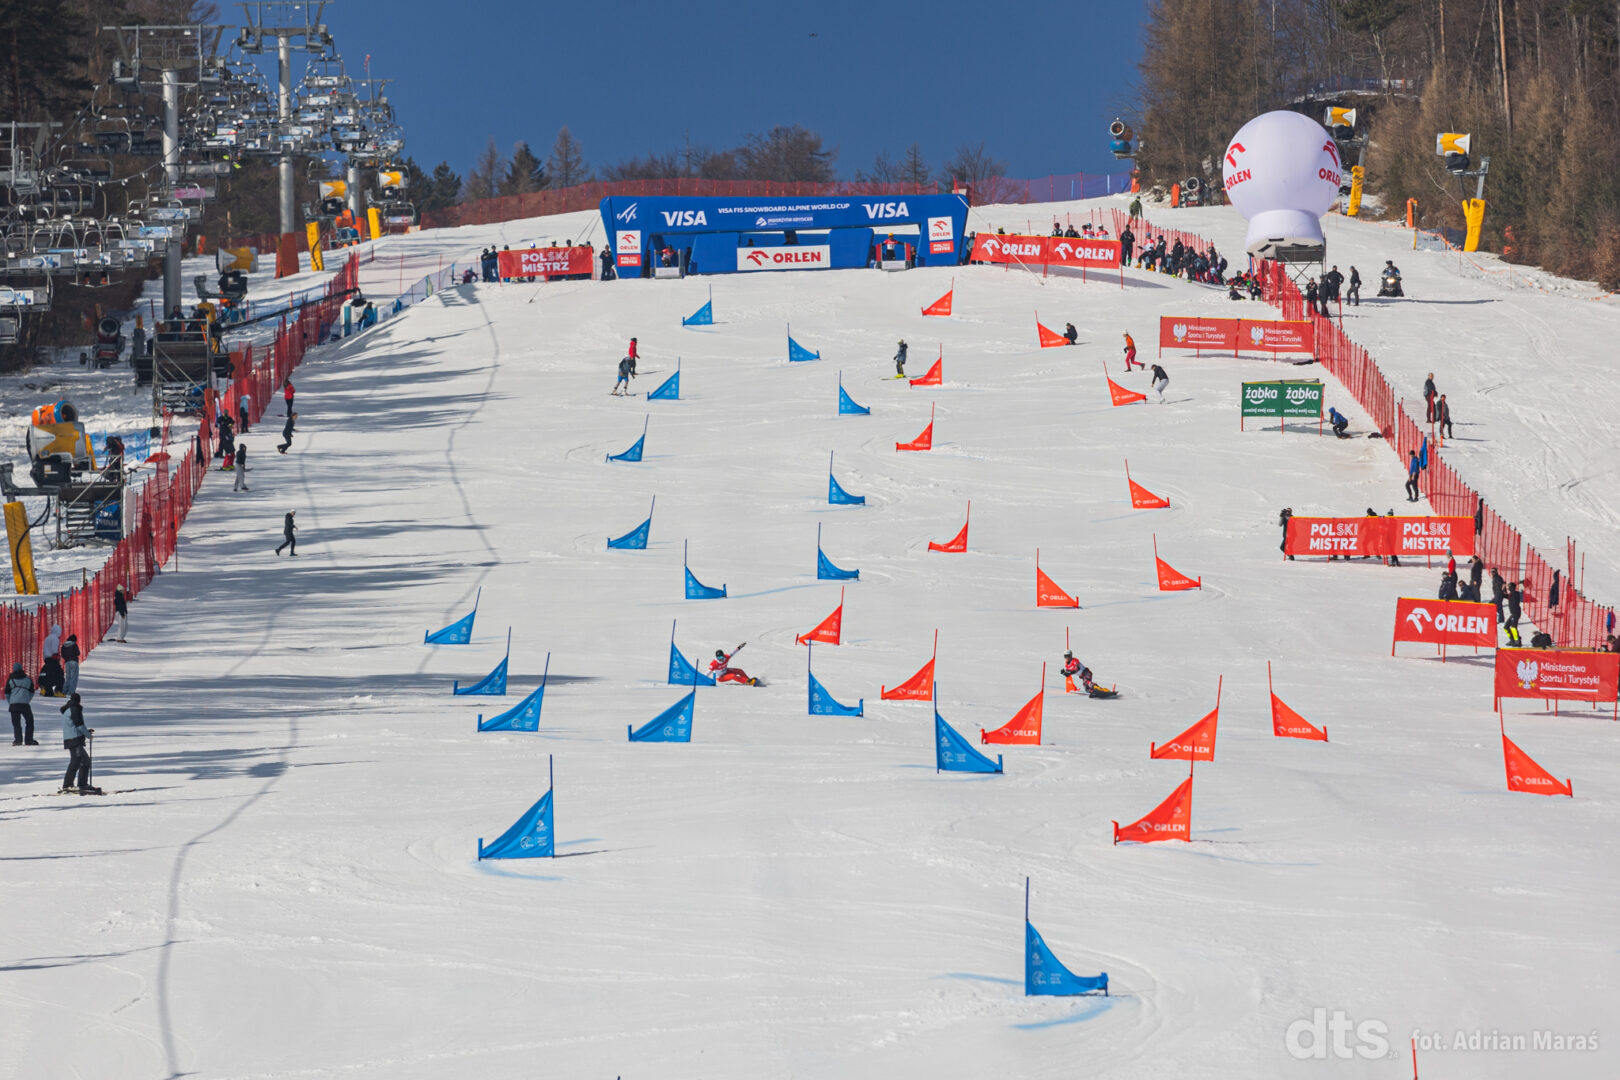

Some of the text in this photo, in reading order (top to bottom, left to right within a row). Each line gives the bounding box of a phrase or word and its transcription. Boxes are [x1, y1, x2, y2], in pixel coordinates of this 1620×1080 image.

[1225, 168, 1252, 190] ORLEN
[861, 202, 910, 219] VISA
[660, 210, 708, 227] VISA
[1002, 243, 1041, 256] ORLEN
[1075, 246, 1114, 261] ORLEN
[521, 251, 569, 263] POLSKI
[773, 251, 822, 263] ORLEN
[522, 261, 570, 273] MISTRZ
[1245, 386, 1278, 399] żabka
[1285, 387, 1319, 400] żabka
[1310, 523, 1359, 537] POLSKI
[1402, 522, 1451, 536] POLSKI
[1309, 537, 1358, 550] MISTRZ
[1402, 537, 1451, 550] MISTRZ
[1434, 613, 1489, 634] ORLEN
[818, 629, 837, 637] ORLEN
[1540, 662, 1586, 673] Ministerstwo
[1540, 673, 1600, 686] Sportu i Turystyki
[906, 687, 929, 696] ORLEN
[1154, 823, 1186, 832] ORLEN
